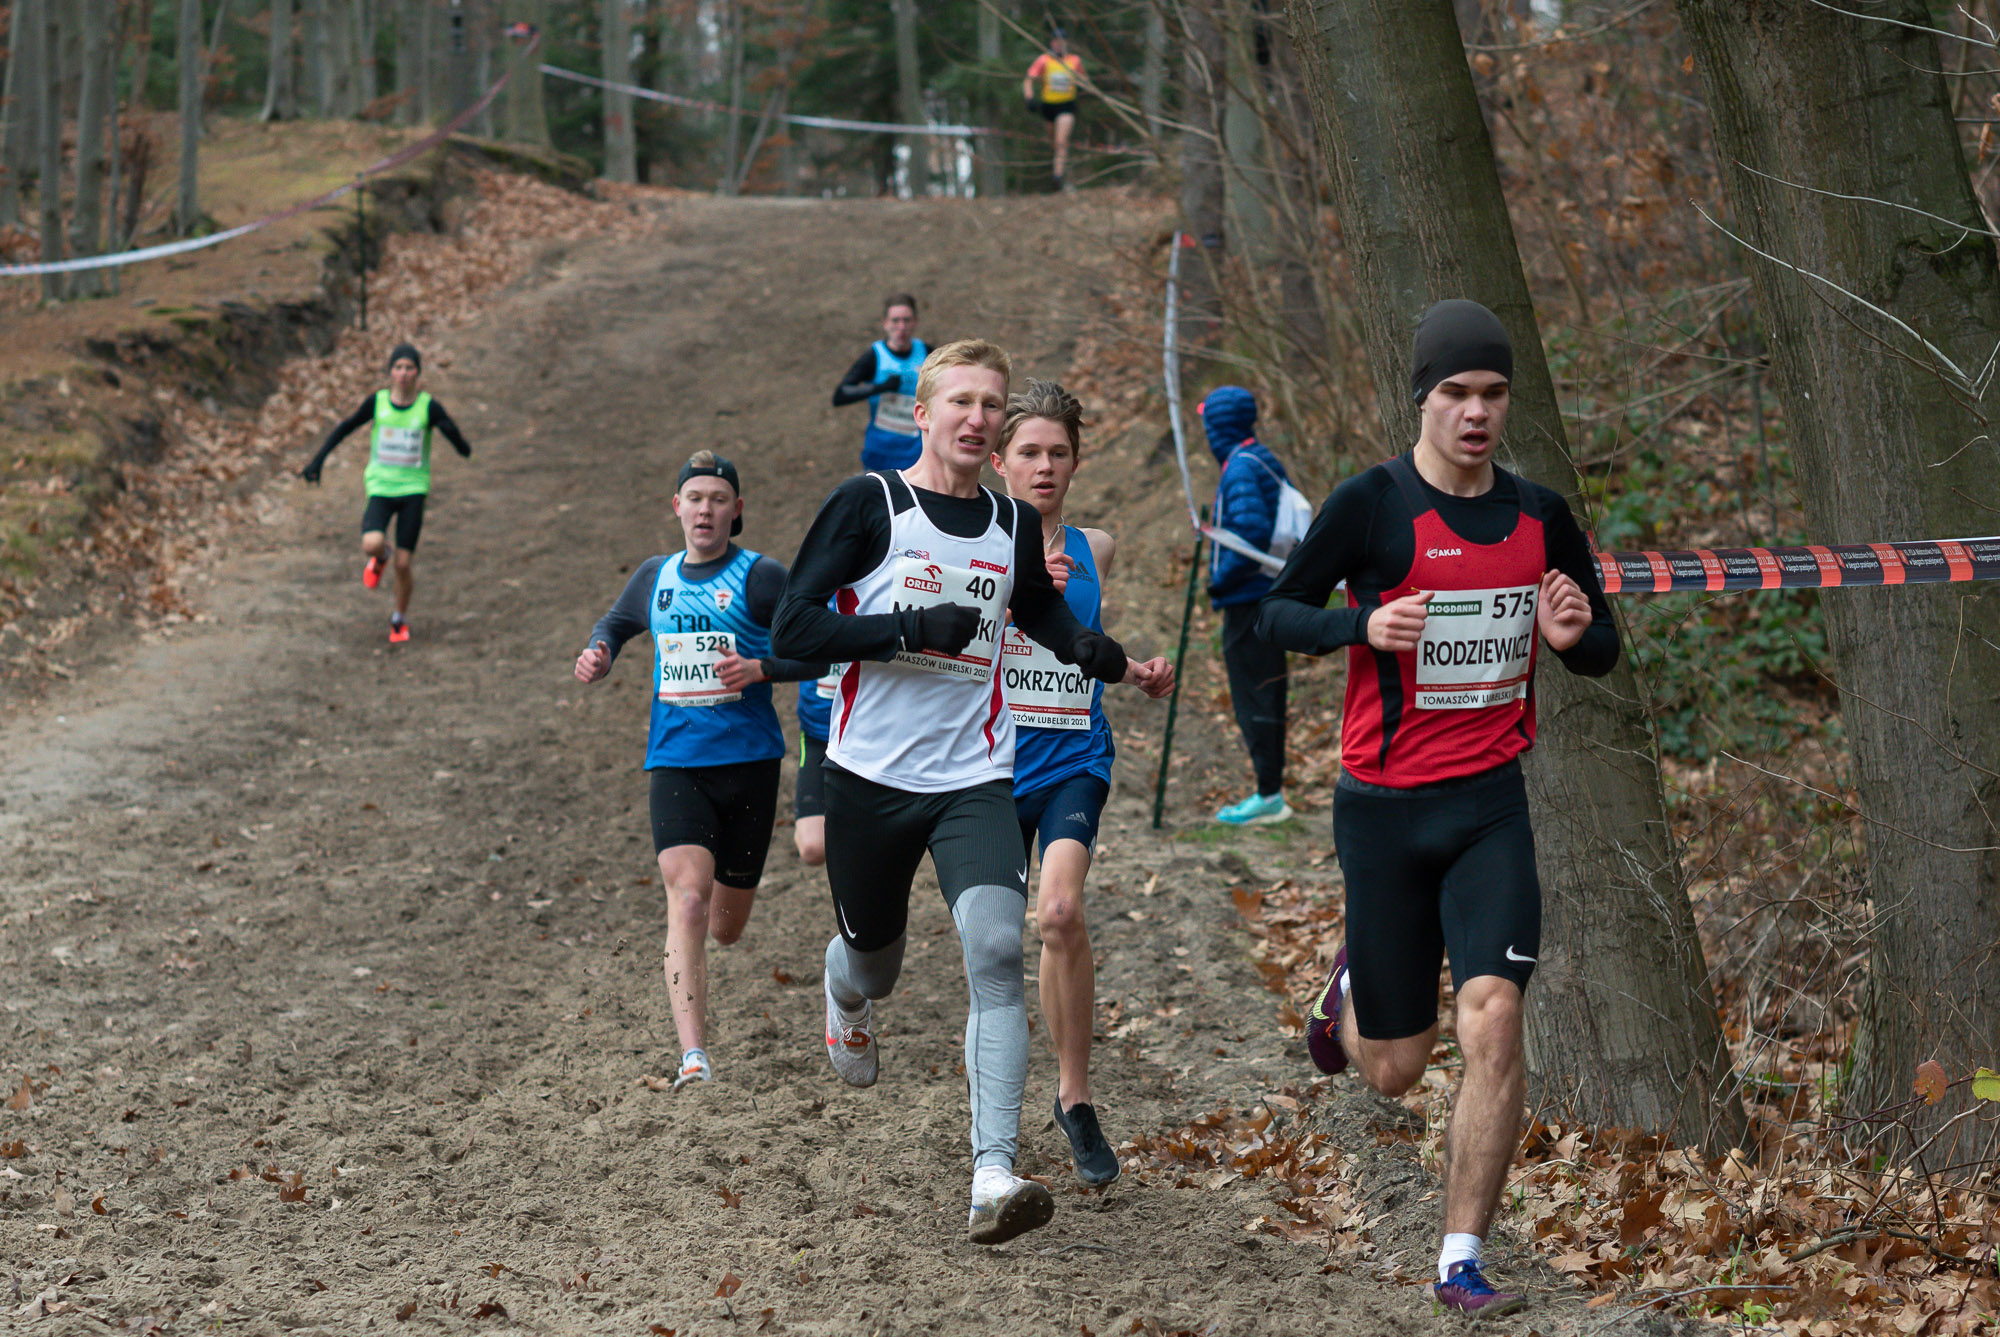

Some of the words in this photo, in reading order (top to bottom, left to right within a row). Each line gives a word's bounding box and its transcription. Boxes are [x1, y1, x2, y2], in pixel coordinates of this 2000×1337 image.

[906, 578, 940, 592] ORLEN
[965, 575, 996, 601] 40
[1428, 603, 1480, 614] BOGDANKA
[1491, 590, 1535, 619] 575
[696, 635, 730, 653] 528
[1422, 632, 1530, 666] RODZIEWICZ
[663, 661, 730, 683] ŚWIĄT
[895, 653, 937, 668] MASZÓW
[938, 661, 972, 675] LUBELSKI
[973, 667, 990, 678] 2021
[1003, 667, 1090, 695] OKRZYCKI
[1423, 693, 1479, 705] TOMASZÓW
[1482, 690, 1511, 703] LUBELSKI
[1012, 712, 1036, 723] SZÓW
[1037, 716, 1070, 726] LUBELSKI
[1071, 718, 1087, 726] 2021
